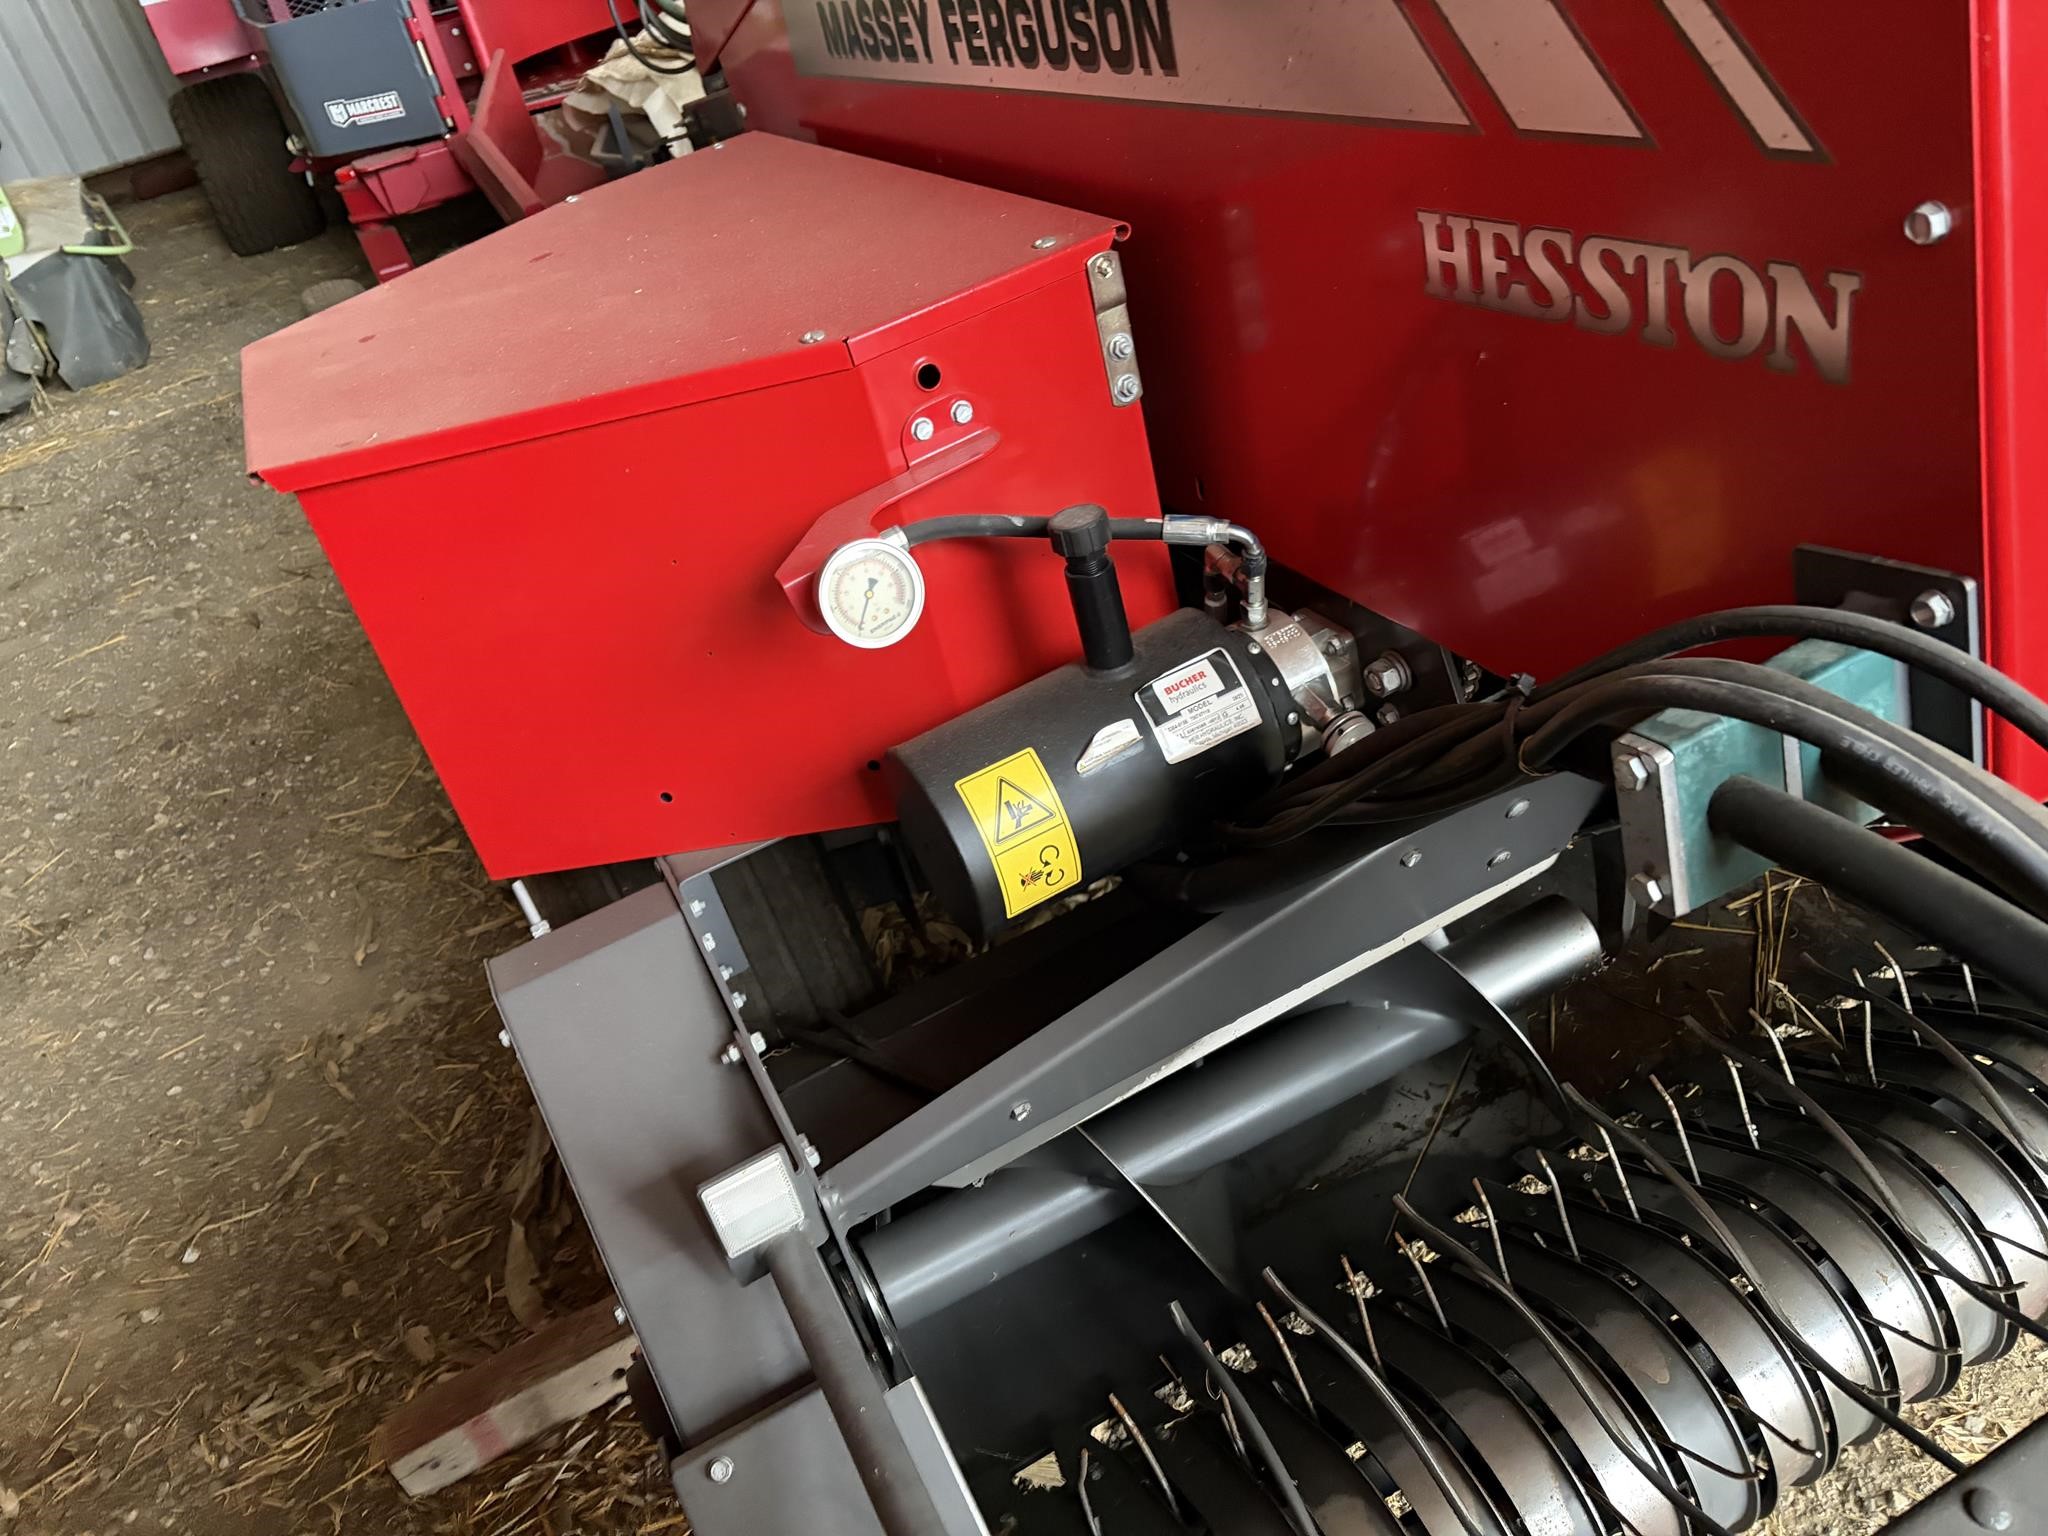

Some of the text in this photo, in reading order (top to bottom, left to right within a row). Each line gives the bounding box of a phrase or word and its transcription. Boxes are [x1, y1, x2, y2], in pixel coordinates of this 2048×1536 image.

[816, 0, 1180, 77] MASSEY FERGUSON
[345, 94, 397, 117] MARCREST
[1415, 207, 1862, 385] HESSTON
[1163, 670, 1207, 696] BUCHER
[1168, 682, 1207, 704] hydraulics
[1187, 700, 1213, 714] MODEL
